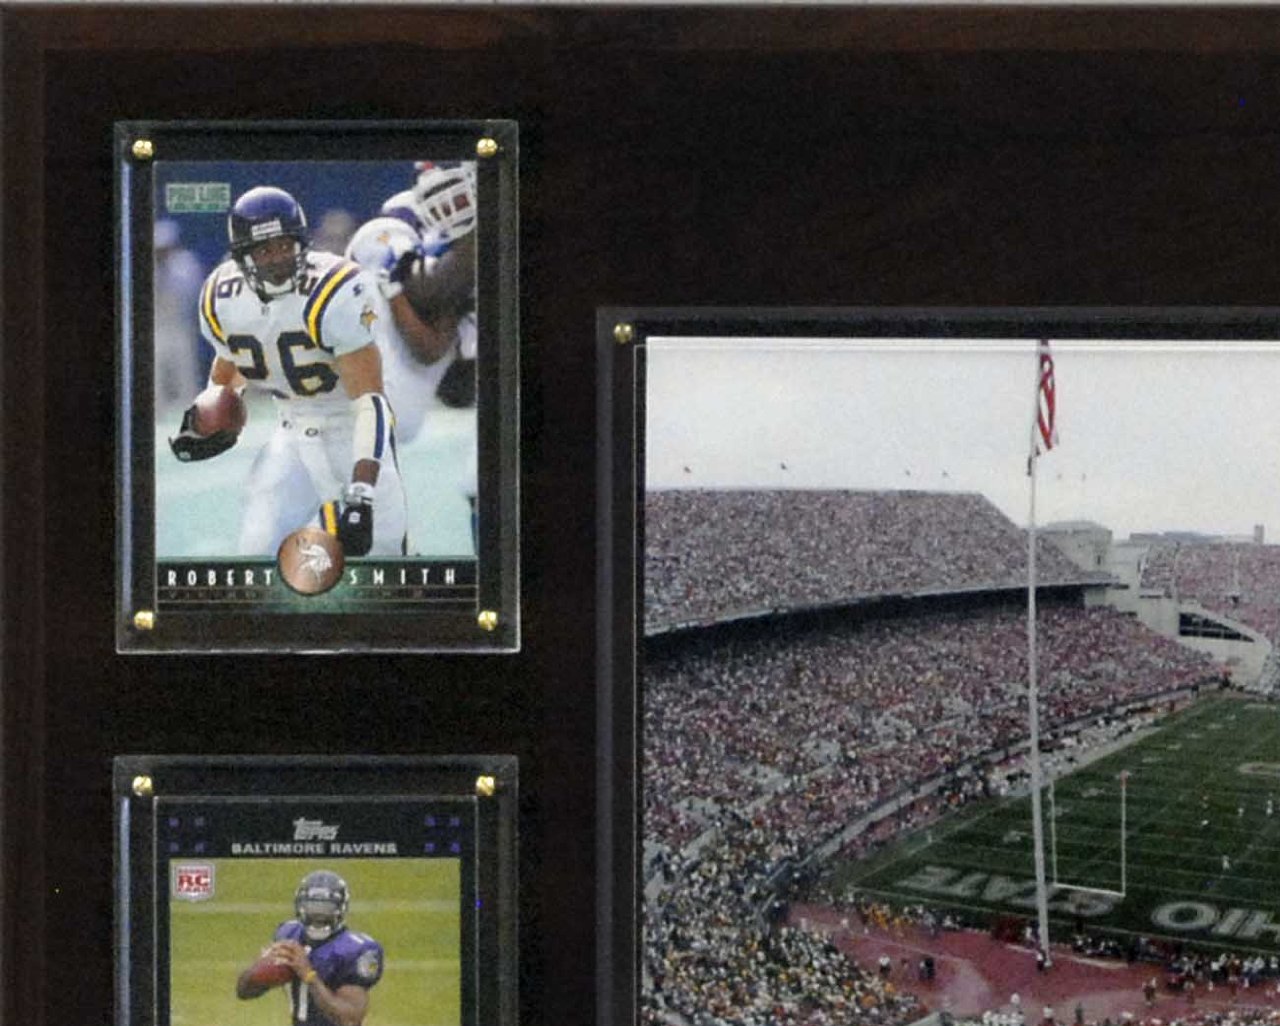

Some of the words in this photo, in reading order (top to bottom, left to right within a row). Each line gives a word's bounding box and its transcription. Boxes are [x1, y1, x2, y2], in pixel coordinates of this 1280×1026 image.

[167, 569, 273, 586] ROBERT
[349, 569, 455, 586] SMITH
[231, 842, 325, 854] BALTIMORE
[330, 842, 398, 854] RAVENS
[178, 874, 209, 888] RC
